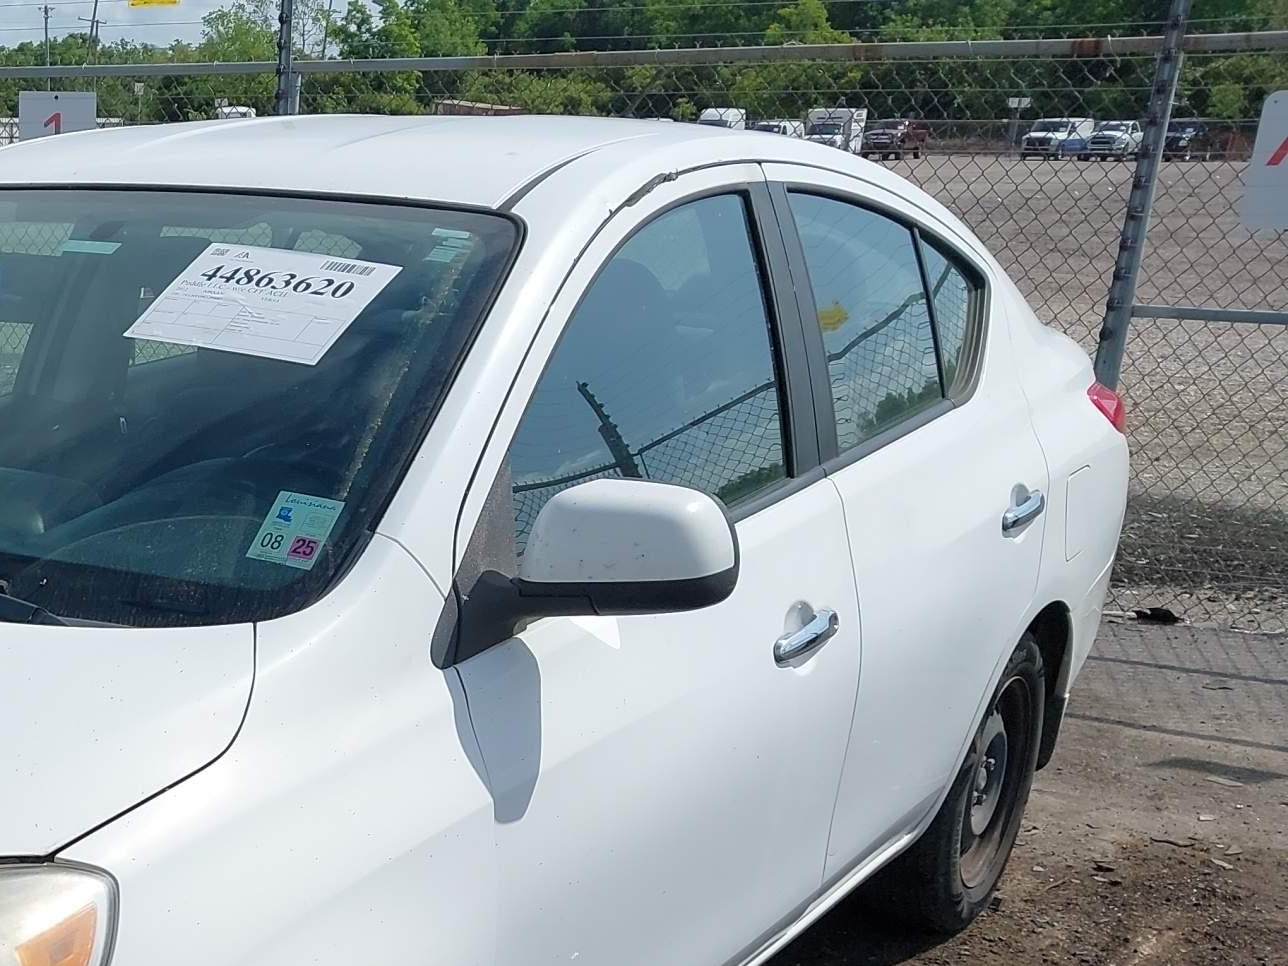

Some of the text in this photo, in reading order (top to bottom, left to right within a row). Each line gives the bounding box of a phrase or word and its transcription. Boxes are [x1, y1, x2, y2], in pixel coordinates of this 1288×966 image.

[200, 264, 356, 299] 44863620
[260, 531, 316, 556] 08 25
